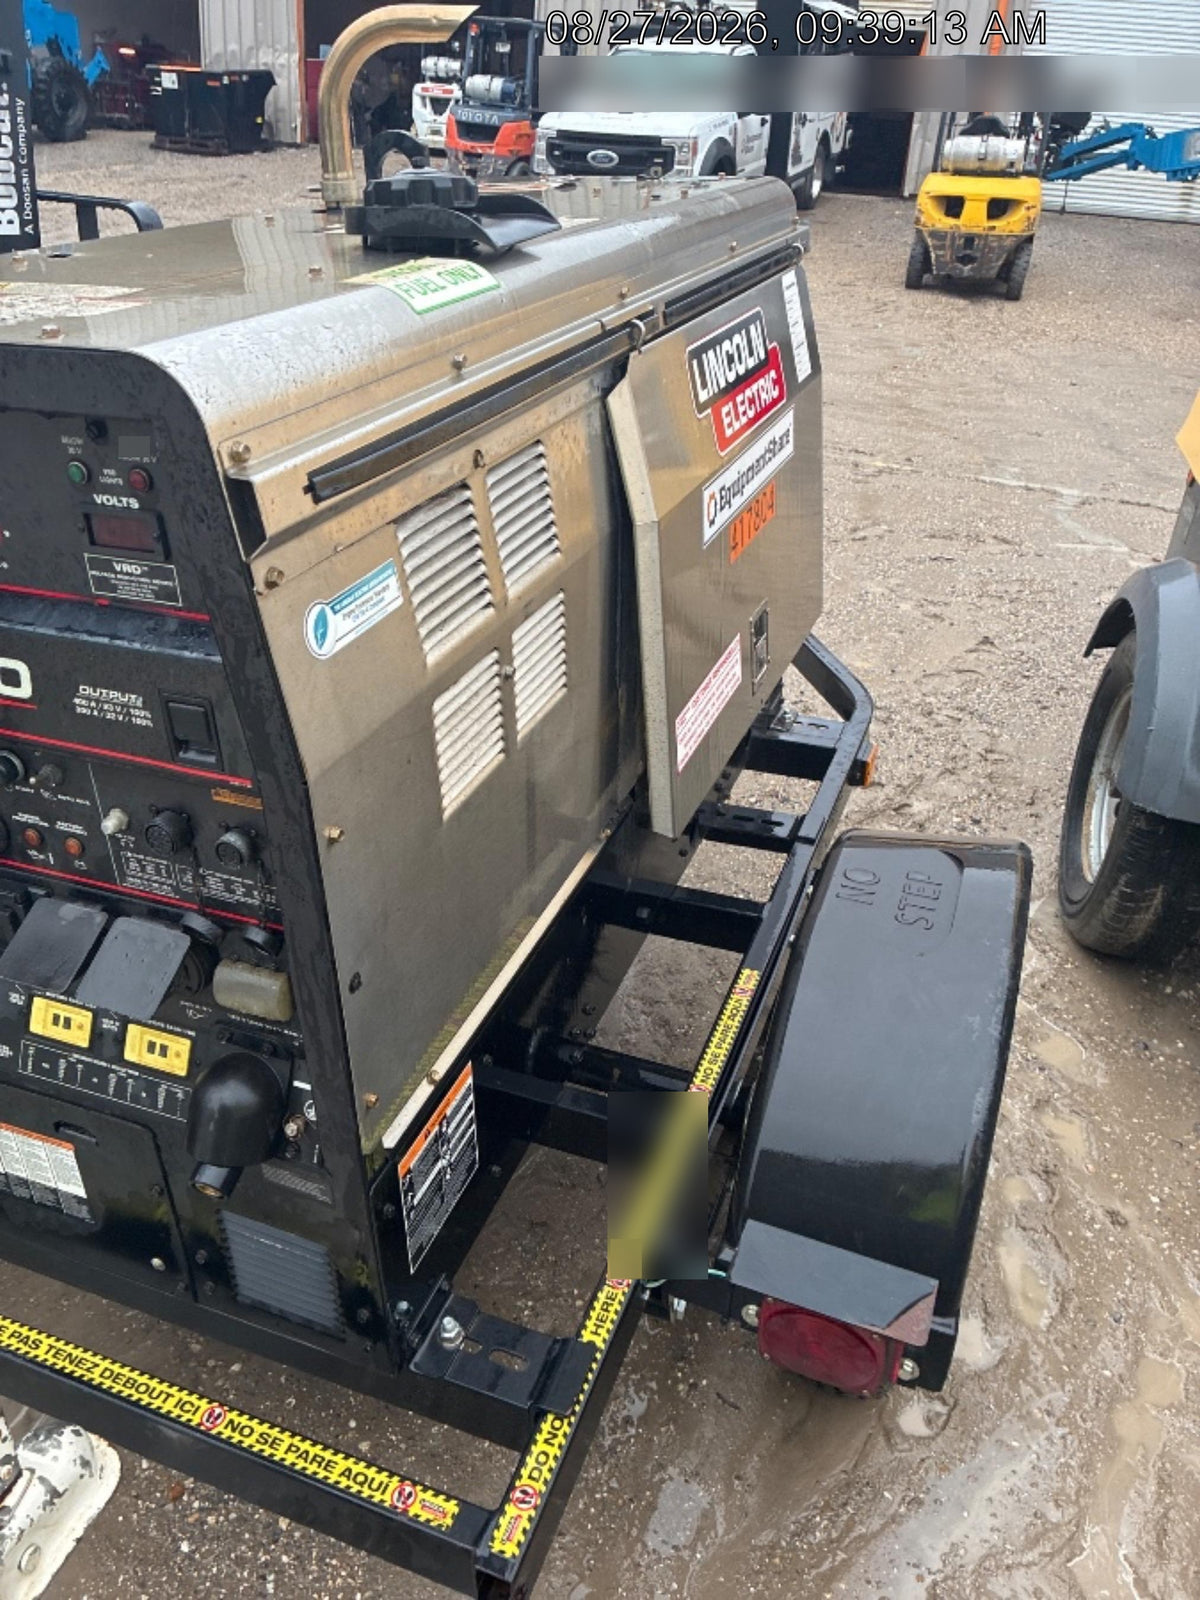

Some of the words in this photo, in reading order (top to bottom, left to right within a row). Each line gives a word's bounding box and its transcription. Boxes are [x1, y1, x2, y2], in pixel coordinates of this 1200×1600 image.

[15, 97, 28, 164] Company
[457, 109, 499, 127] TOYOTA
[24, 223, 34, 234] A
[395, 275, 447, 298] FUEL
[436, 263, 484, 286] ONLY
[692, 319, 766, 404] LINCOLN
[720, 369, 780, 438] ELECTRIC
[93, 493, 140, 509] VOLTS
[835, 867, 881, 905] NO
[894, 870, 943, 930] STEP
[590, 1289, 620, 1338] HERE
[7, 1328, 44, 1351] PAS
[44, 1341, 101, 1374] TENEZ
[99, 1366, 175, 1404] DEBOUT
[174, 1396, 202, 1416] ICI
[223, 1417, 255, 1439] NO
[255, 1432, 283, 1451] SE
[283, 1445, 341, 1473] PARE
[527, 1450, 551, 1483] DO
[544, 1415, 566, 1448] NO
